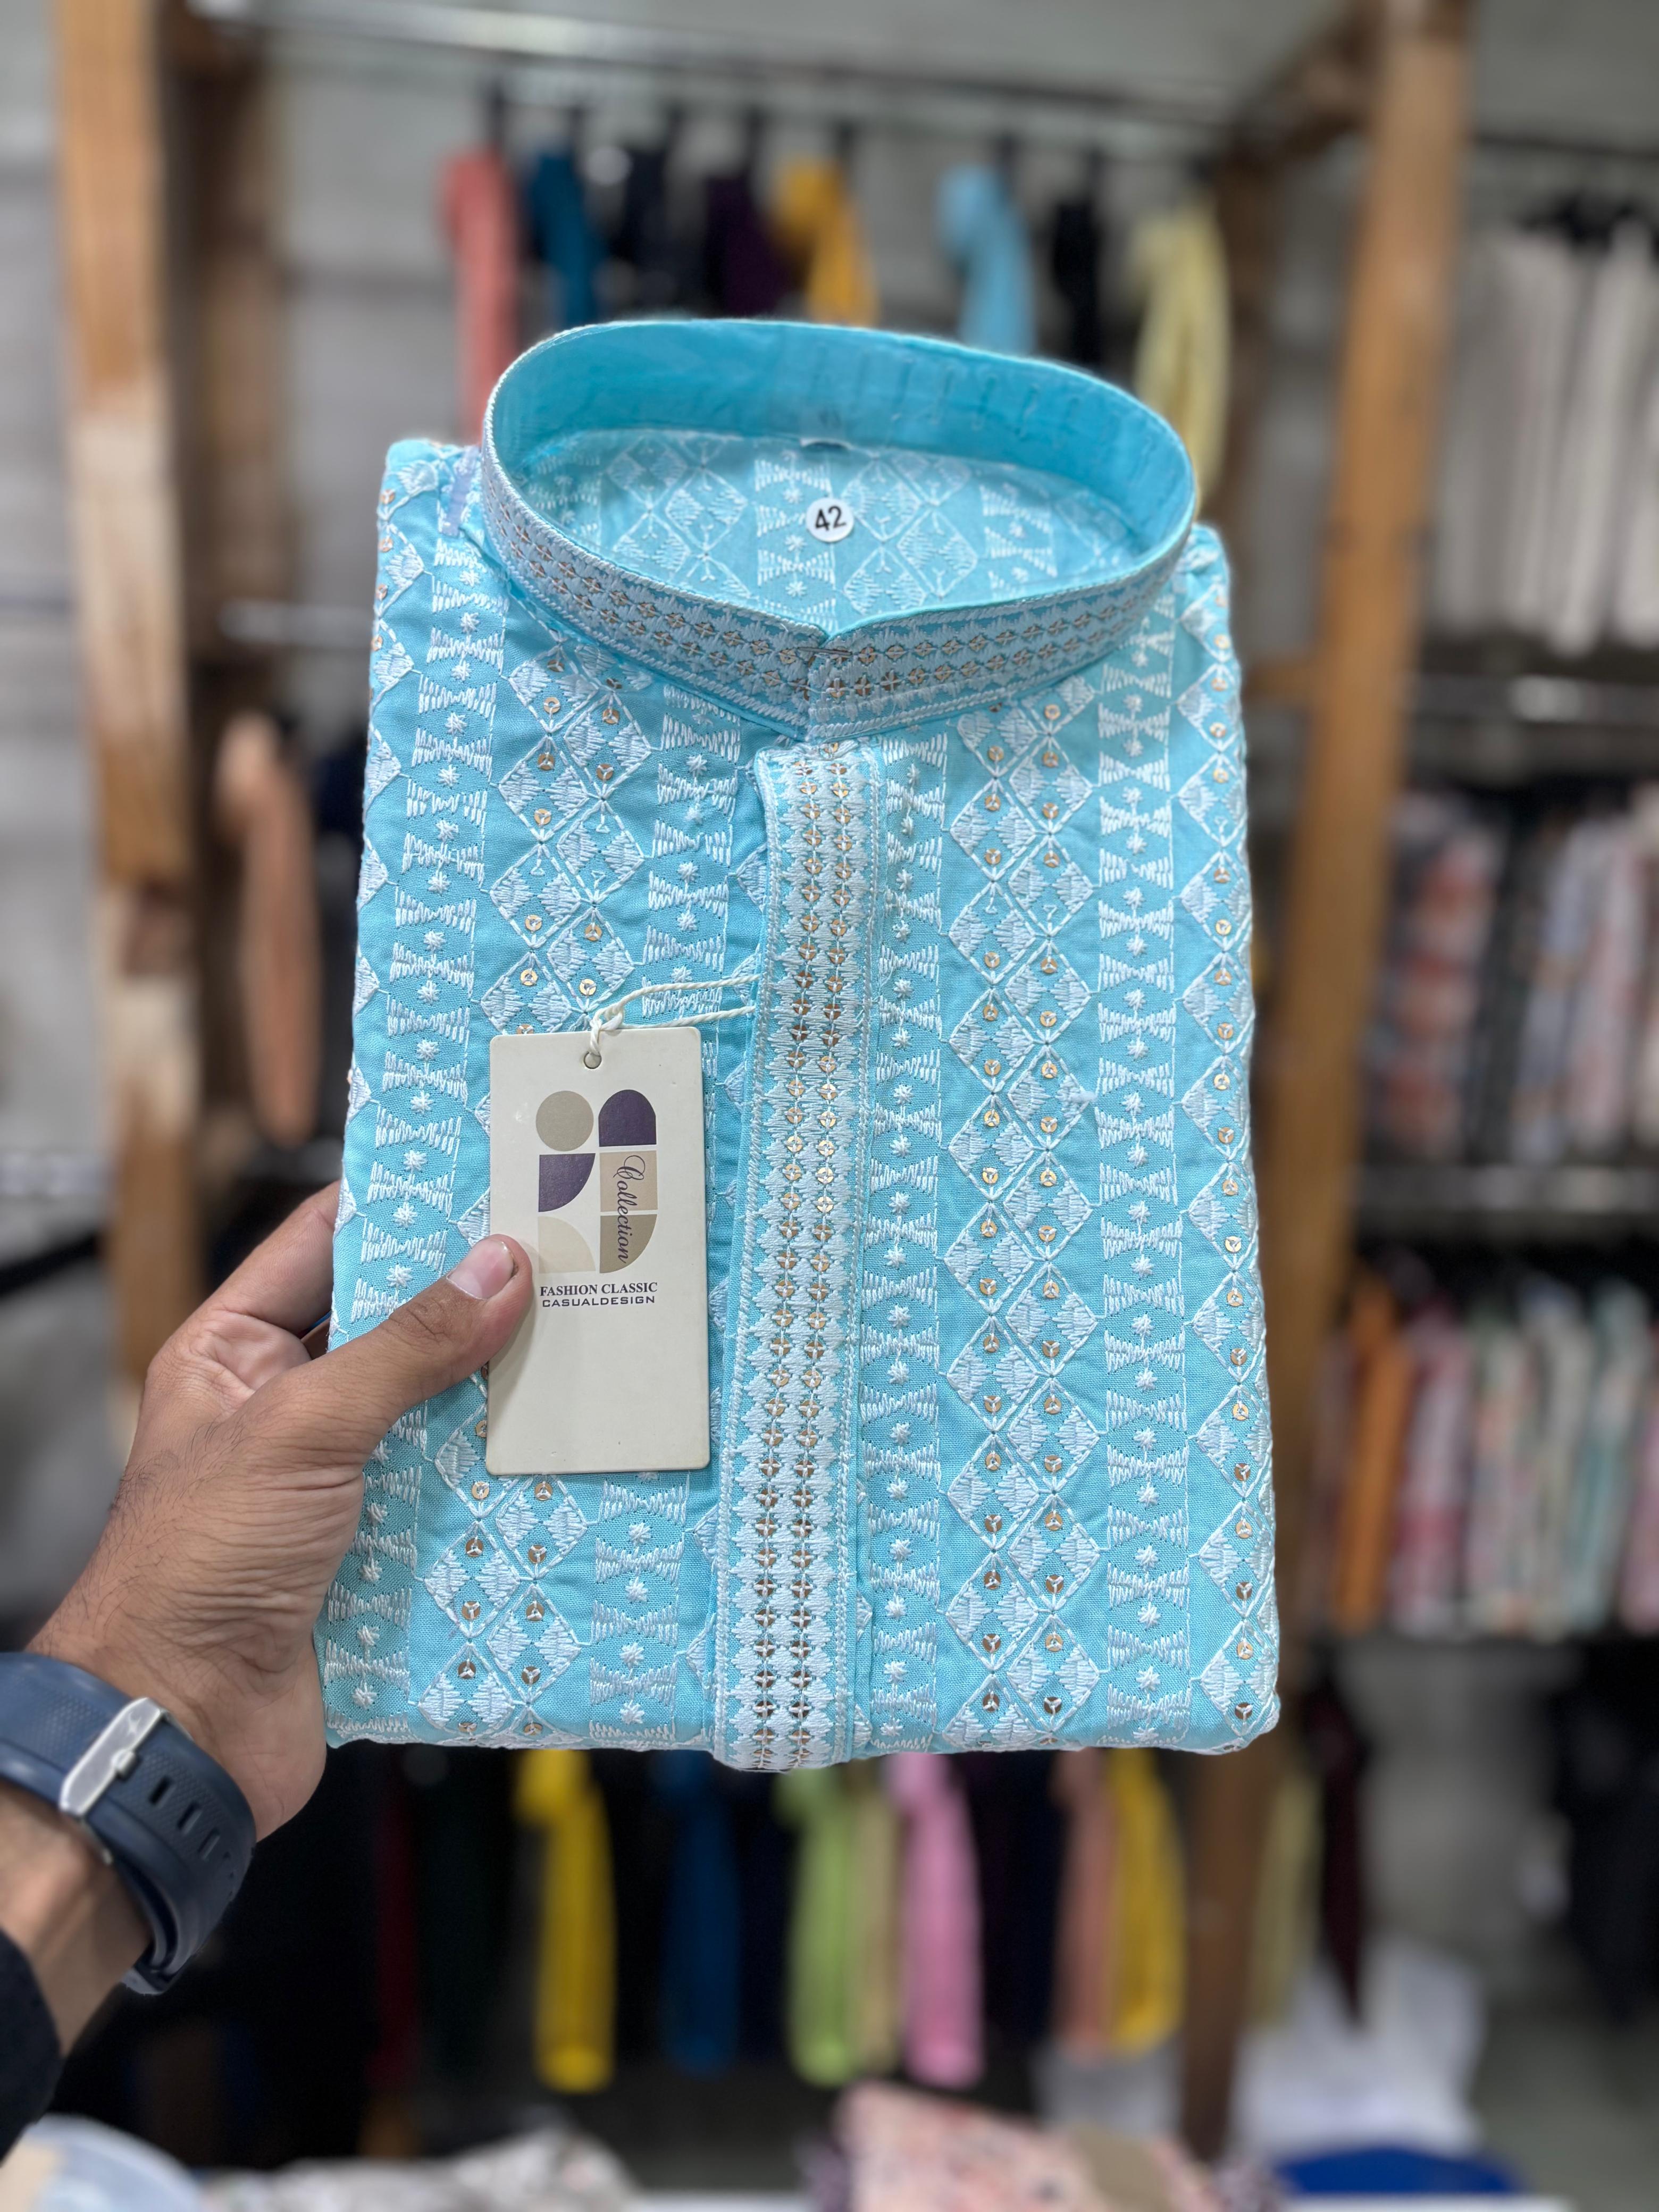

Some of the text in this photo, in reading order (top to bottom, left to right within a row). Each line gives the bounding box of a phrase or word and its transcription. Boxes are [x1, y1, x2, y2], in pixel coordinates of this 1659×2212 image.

[815, 505, 847, 531] 42
[613, 1154, 646, 1264] Collection
[540, 1282, 658, 1296] FASHION CLASSIC
[542, 1295, 655, 1308] CASUALDESIGN
